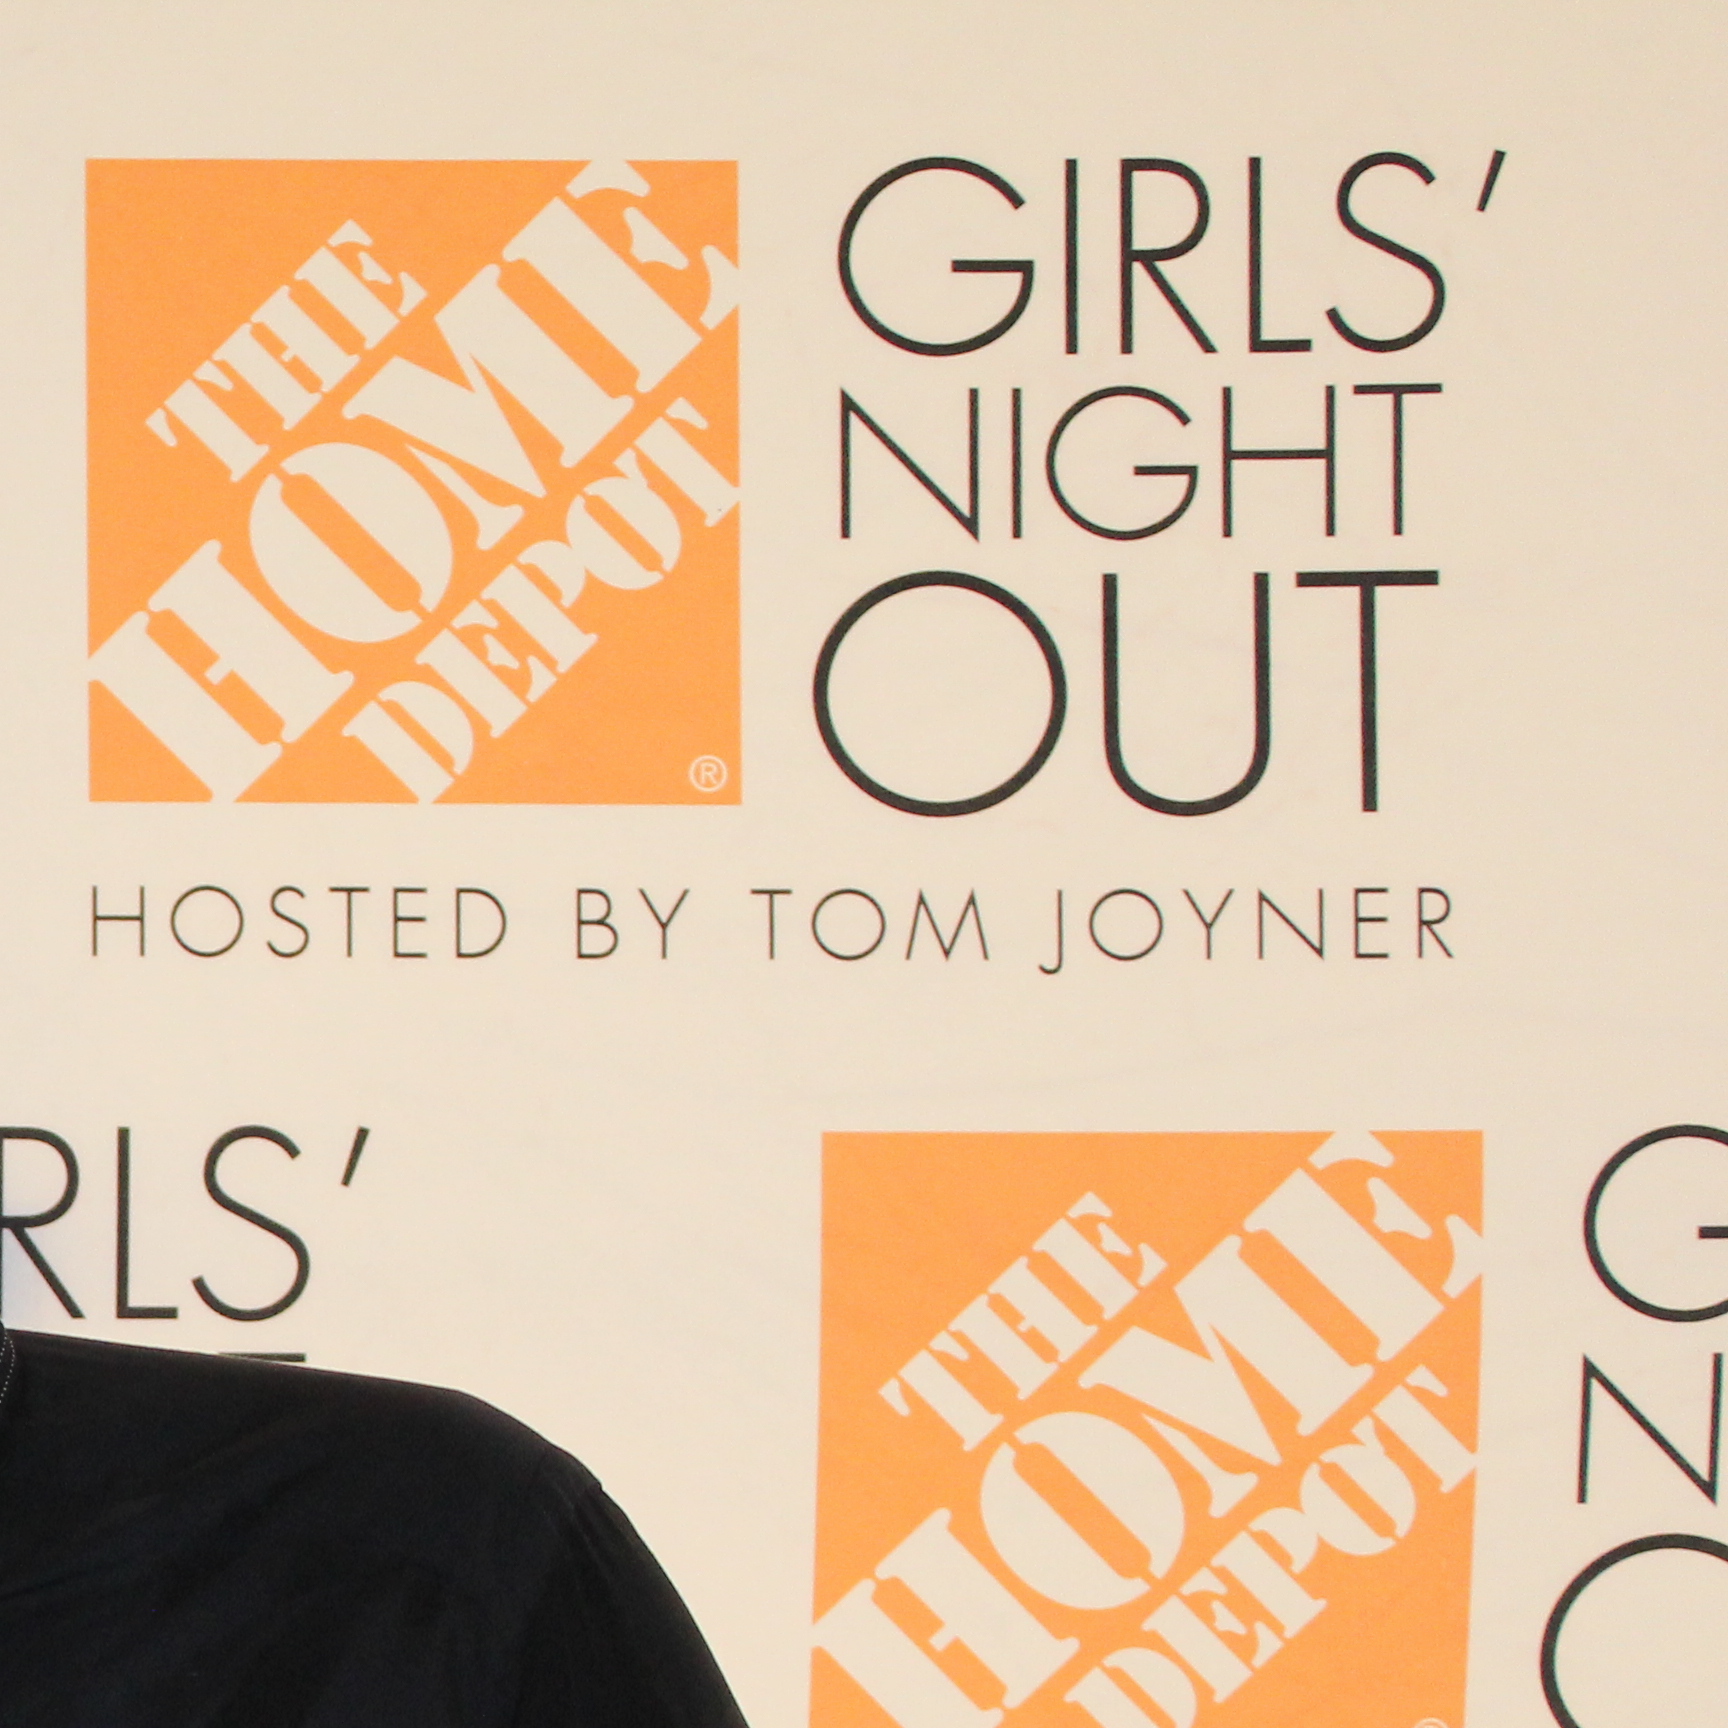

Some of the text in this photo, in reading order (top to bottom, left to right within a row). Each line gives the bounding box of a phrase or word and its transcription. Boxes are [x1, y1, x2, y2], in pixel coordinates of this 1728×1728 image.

[144, 218, 429, 487] THE
[836, 149, 1508, 357] GIRLS'
[87, 158, 739, 803] HOME
[839, 382, 1444, 543] NIGHT
[341, 395, 740, 804] DEPOT
[811, 569, 1440, 818] OUT
[90, 884, 1455, 977] HOSTED BY TOM JOYNER
[877, 1190, 1168, 1452] THE
